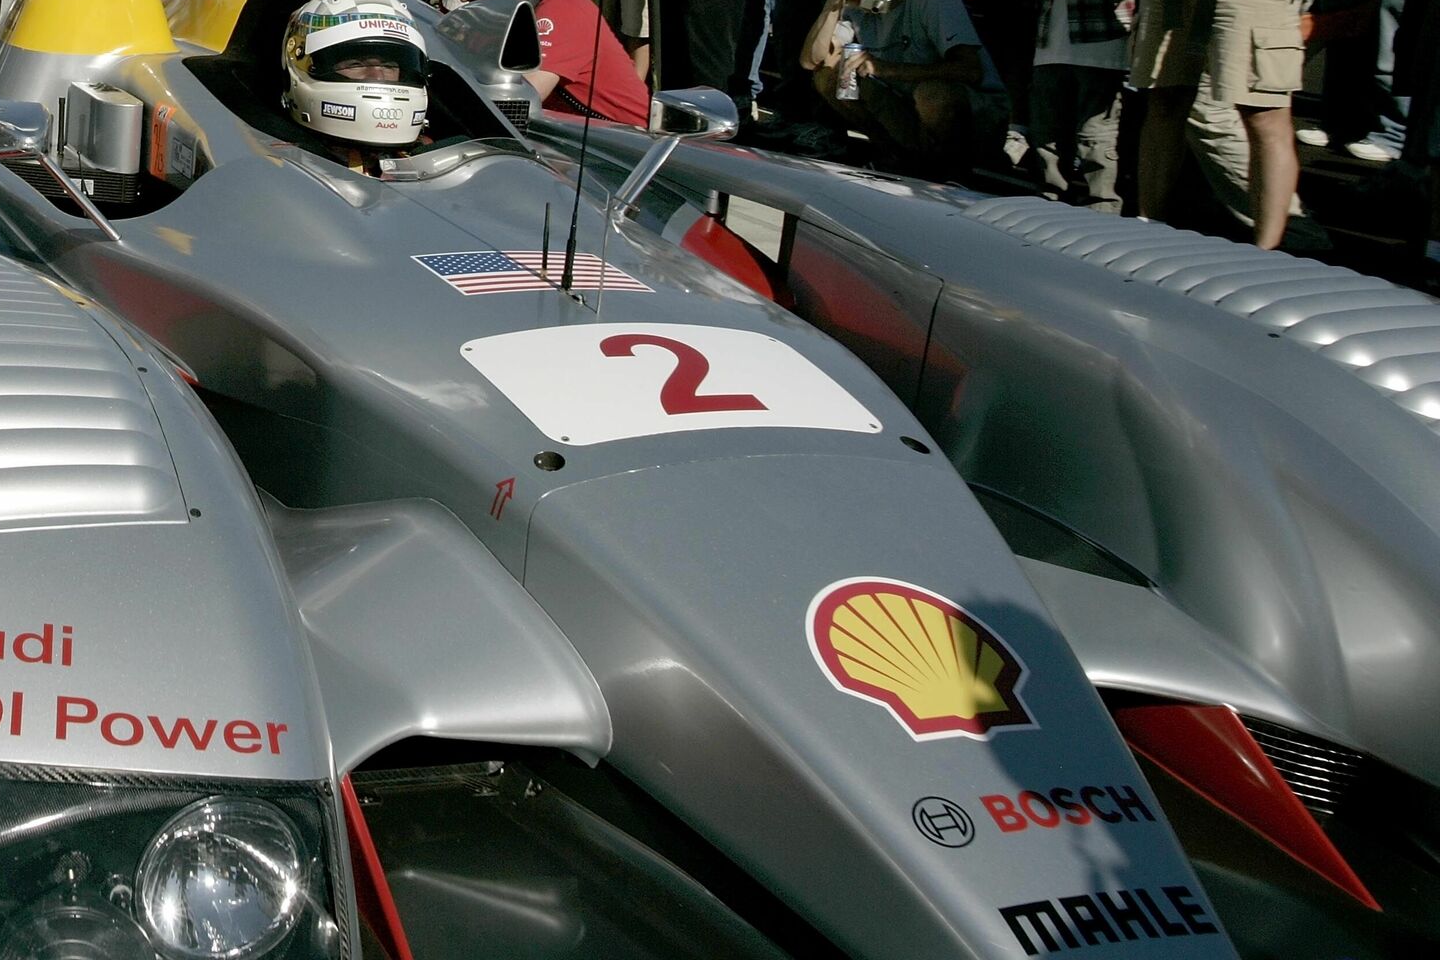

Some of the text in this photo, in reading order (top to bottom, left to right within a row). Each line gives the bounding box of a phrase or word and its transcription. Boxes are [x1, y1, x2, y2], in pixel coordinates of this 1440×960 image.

[359, 19, 409, 34] UNIPART
[323, 102, 355, 117] JEWSON
[375, 121, 398, 130] Audi
[599, 333, 770, 416] 2
[55, 695, 289, 755] Power
[979, 785, 1157, 834] BOSCH
[997, 886, 1220, 957] MAHLE
